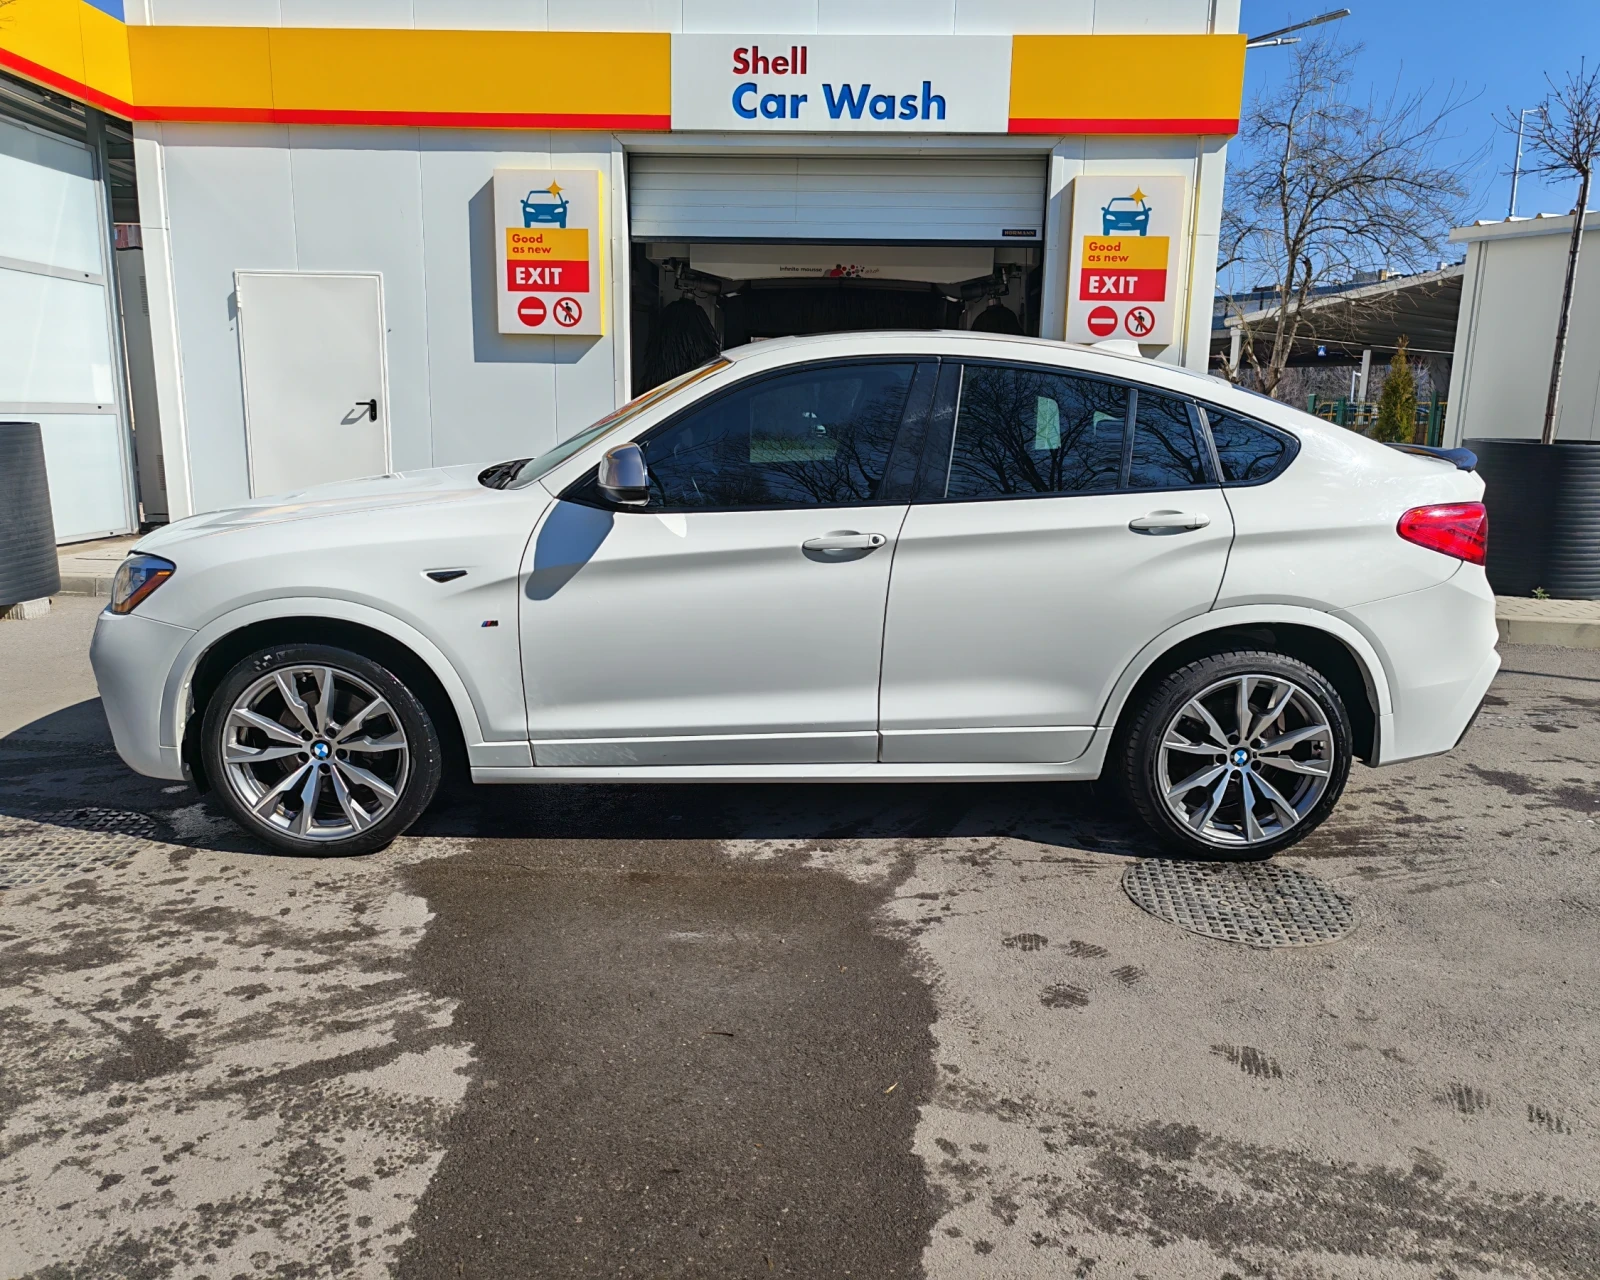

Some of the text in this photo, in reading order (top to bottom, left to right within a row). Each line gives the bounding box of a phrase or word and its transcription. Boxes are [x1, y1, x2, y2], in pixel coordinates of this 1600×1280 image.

[732, 46, 808, 76] Shell
[731, 81, 947, 121] Car Wash
[511, 233, 544, 244] Good
[511, 245, 552, 254] as new
[1088, 241, 1122, 252] Good
[1087, 254, 1130, 263] as new
[514, 266, 563, 286] EXIT
[1088, 275, 1139, 295] EXIT
